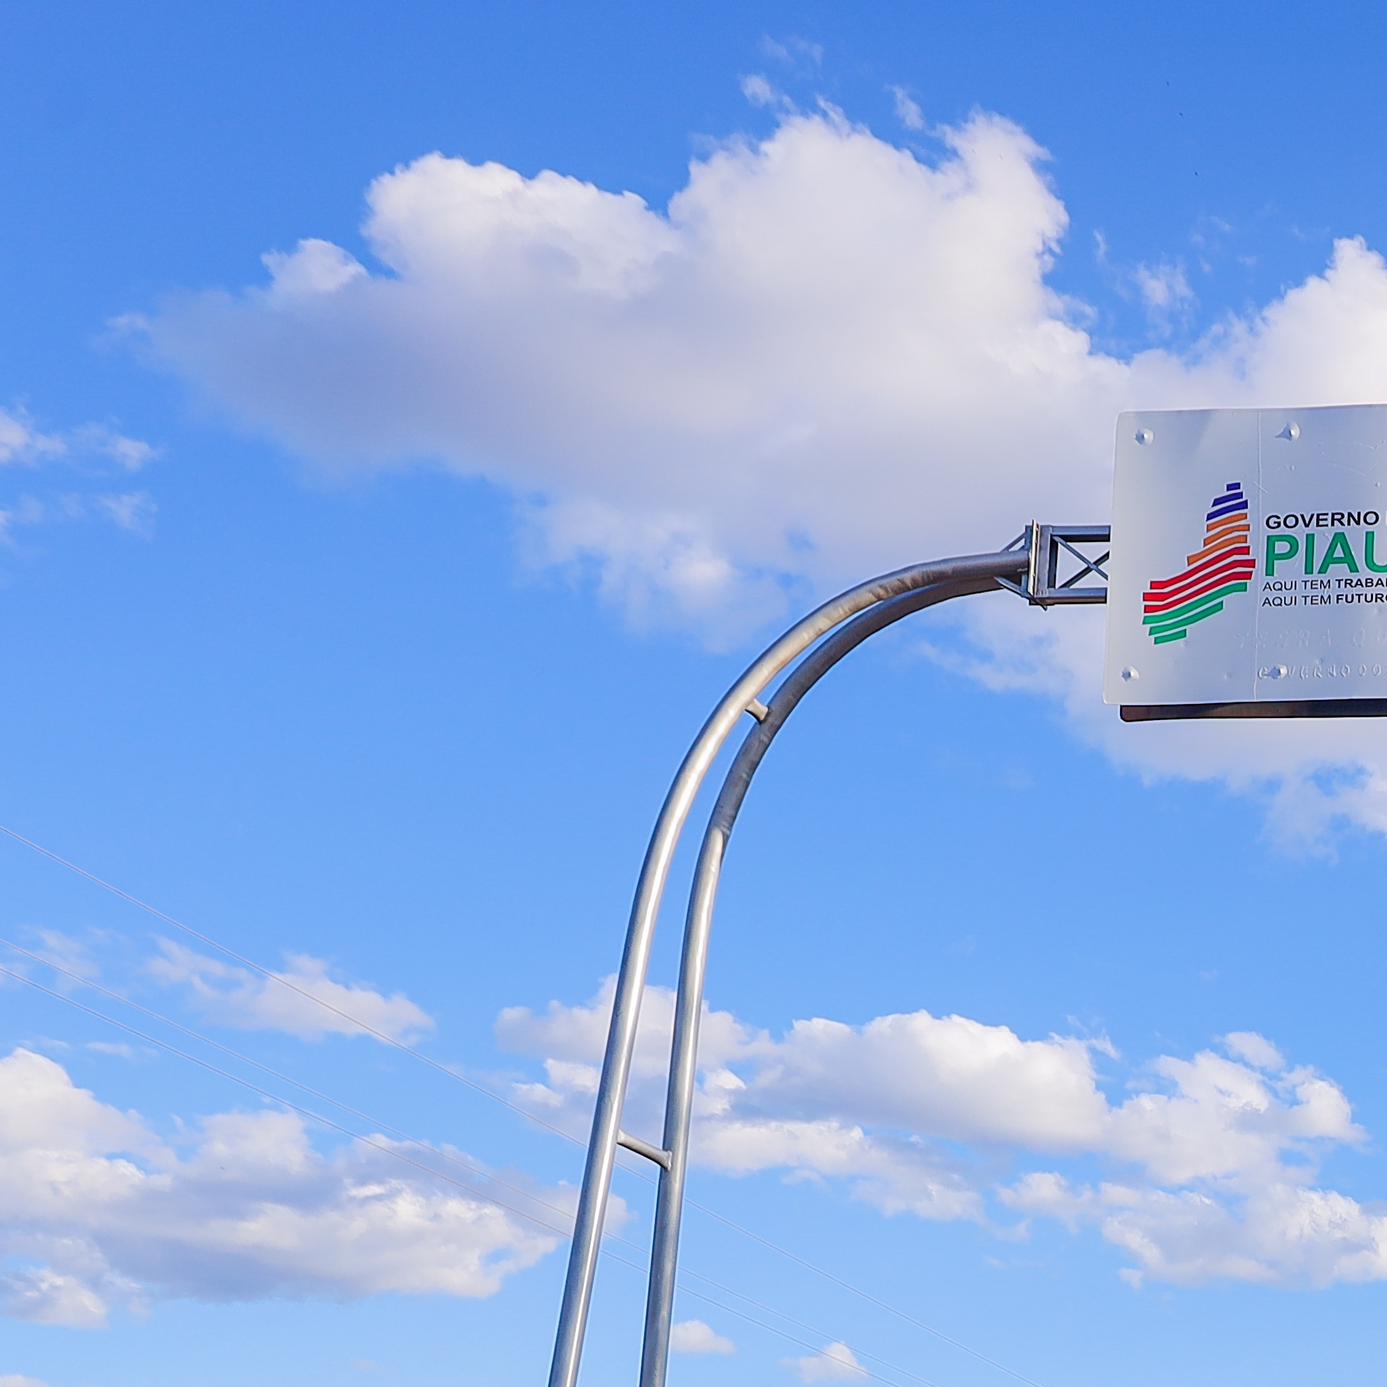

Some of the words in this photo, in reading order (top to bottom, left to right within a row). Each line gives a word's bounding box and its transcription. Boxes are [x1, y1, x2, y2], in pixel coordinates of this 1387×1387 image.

[1265, 511, 1381, 530] GOVERNO
[1262, 579, 1296, 593] AQUI
[1300, 578, 1331, 591] TEM
[1262, 596, 1296, 608] AQUI
[1300, 594, 1331, 606] TEM
